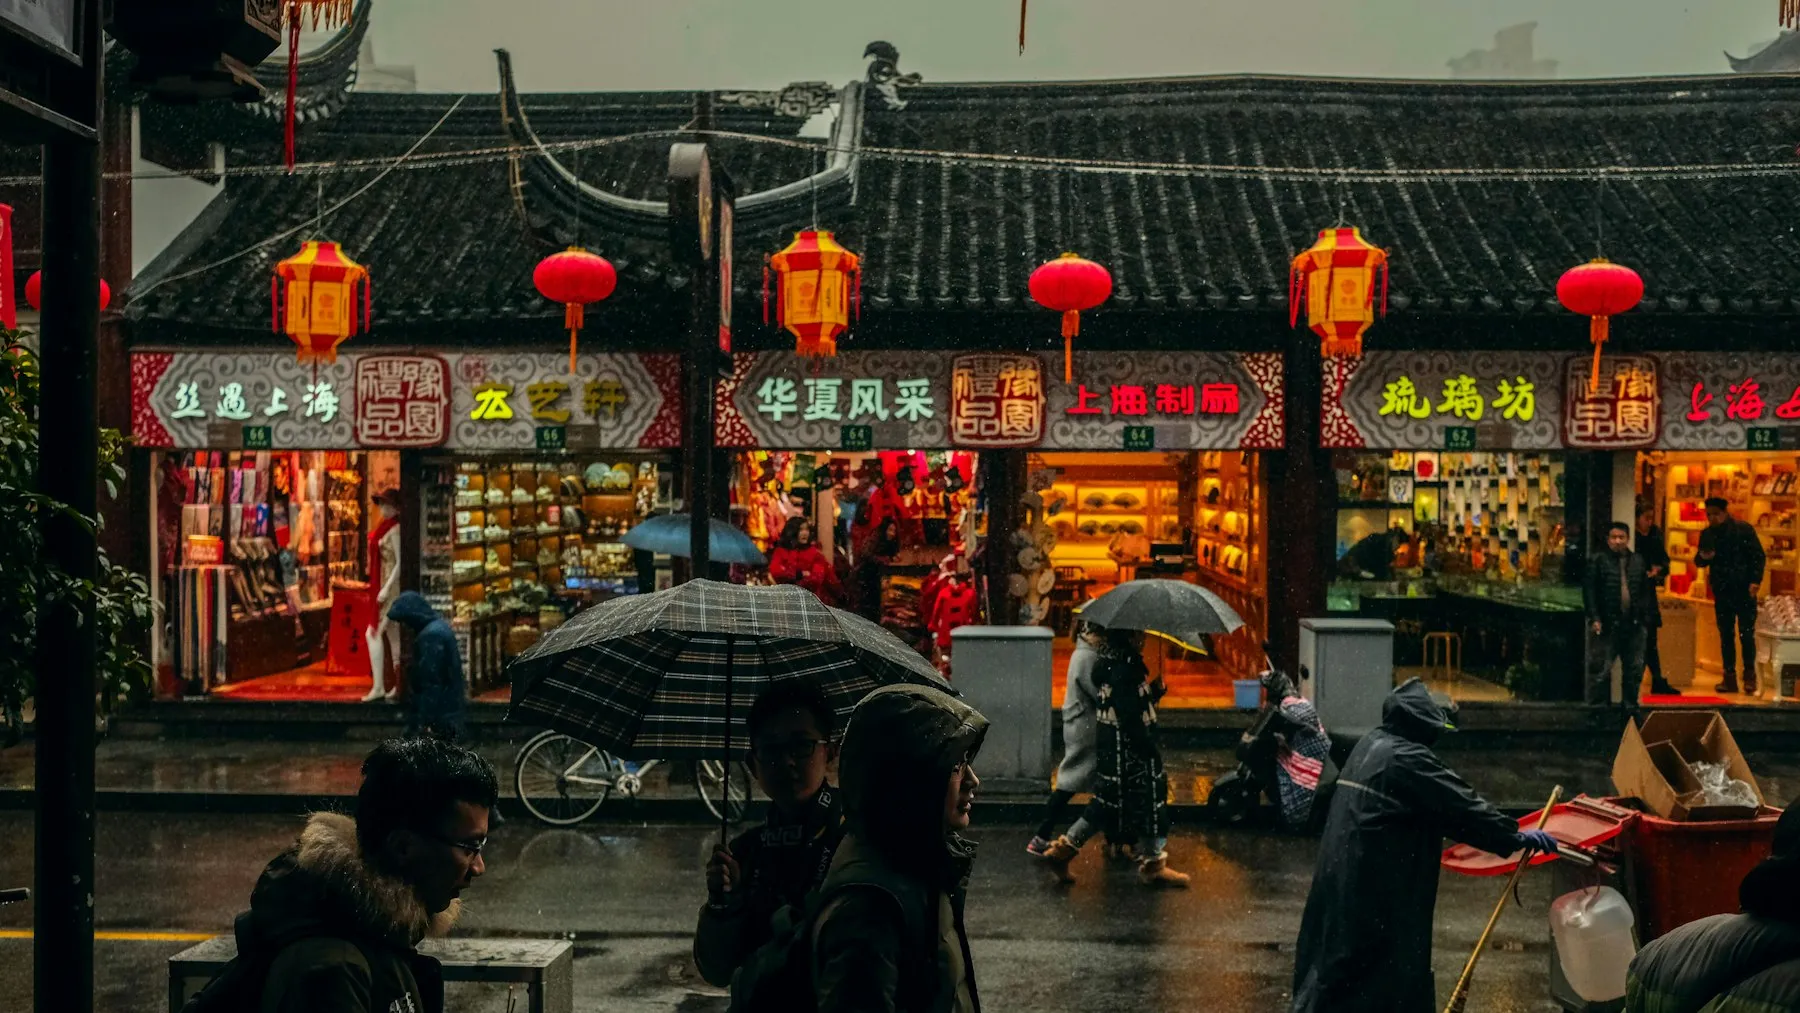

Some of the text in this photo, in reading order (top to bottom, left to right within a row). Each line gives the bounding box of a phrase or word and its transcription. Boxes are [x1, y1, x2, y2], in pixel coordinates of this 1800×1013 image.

[171, 382, 340, 423] 丝遇上海
[756, 377, 934, 422] 华夏风采
[1066, 382, 1240, 415] 上海制扇
[1377, 374, 1536, 422] 琉璃坊
[249, 427, 265, 441] 66
[543, 428, 558, 441] 66
[849, 427, 865, 441] 64
[1452, 428, 1468, 442] 62
[1755, 429, 1770, 442] 62
